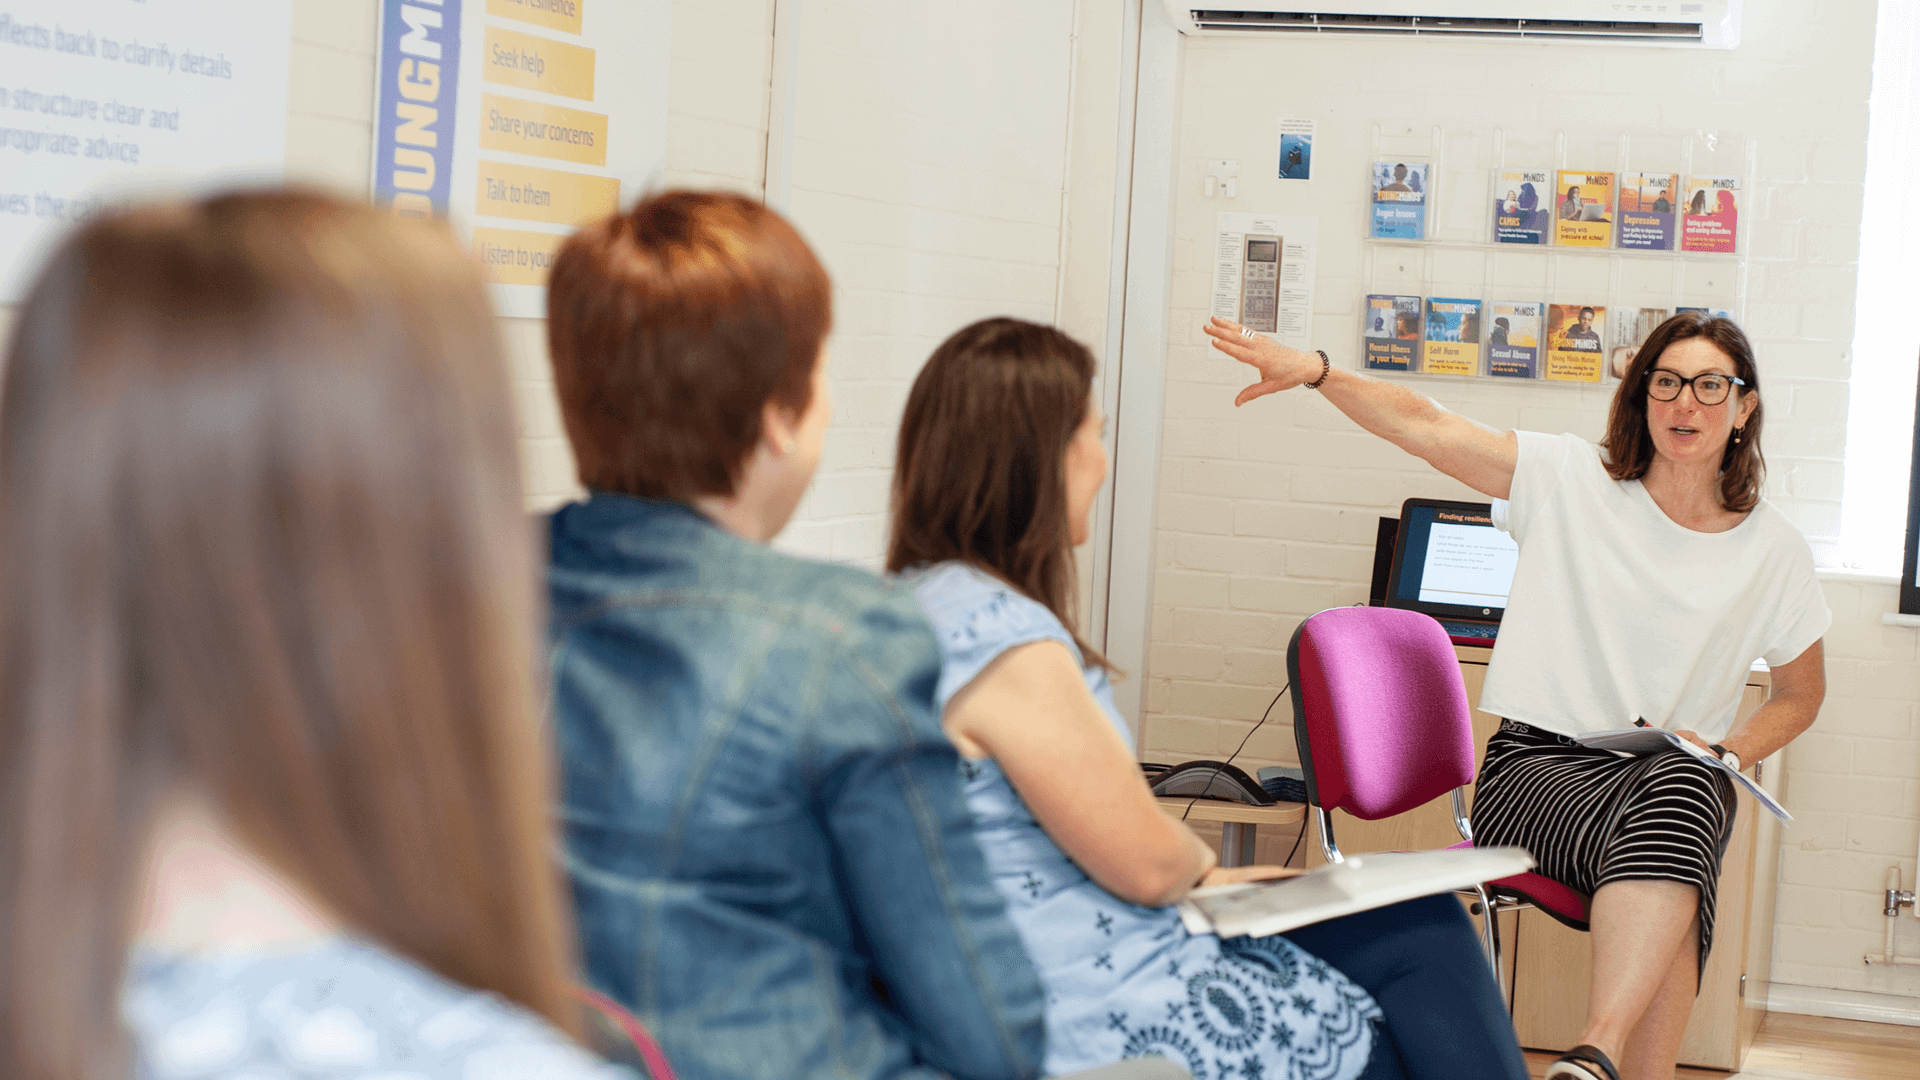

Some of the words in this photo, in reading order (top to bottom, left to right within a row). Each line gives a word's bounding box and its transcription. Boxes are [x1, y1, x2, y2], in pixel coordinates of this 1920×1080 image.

[54, 24, 97, 57] back
[101, 36, 121, 61] to
[123, 37, 176, 75] clarify
[179, 46, 233, 80] details
[492, 43, 520, 69] Seek
[520, 48, 546, 79] help
[12, 87, 98, 121] structure
[102, 97, 145, 126] clear
[148, 107, 180, 132] and
[489, 108, 522, 136] Share
[523, 120, 548, 141] your
[548, 124, 594, 147] concerns
[83, 133, 140, 165] advice
[486, 178, 508, 202] Talk
[509, 182, 522, 205] to
[523, 182, 551, 207] them
[1376, 208, 1394, 220] Anger
[1624, 214, 1660, 226] Depression
[1498, 216, 1521, 227] CAMHS
[1701, 220, 1722, 228] problems
[1561, 225, 1576, 234] Coping
[1710, 227, 1731, 235] disorders
[517, 246, 529, 267] to
[1369, 342, 1389, 352] Mental
[1430, 346, 1442, 355] Self
[1443, 347, 1460, 356] Harm
[1492, 347, 1512, 359] Sexual
[1512, 349, 1531, 360] Abuse
[1369, 354, 1375, 362] in
[1376, 356, 1389, 364] your
[1391, 354, 1411, 366] family
[1439, 513, 1464, 522] Finding
